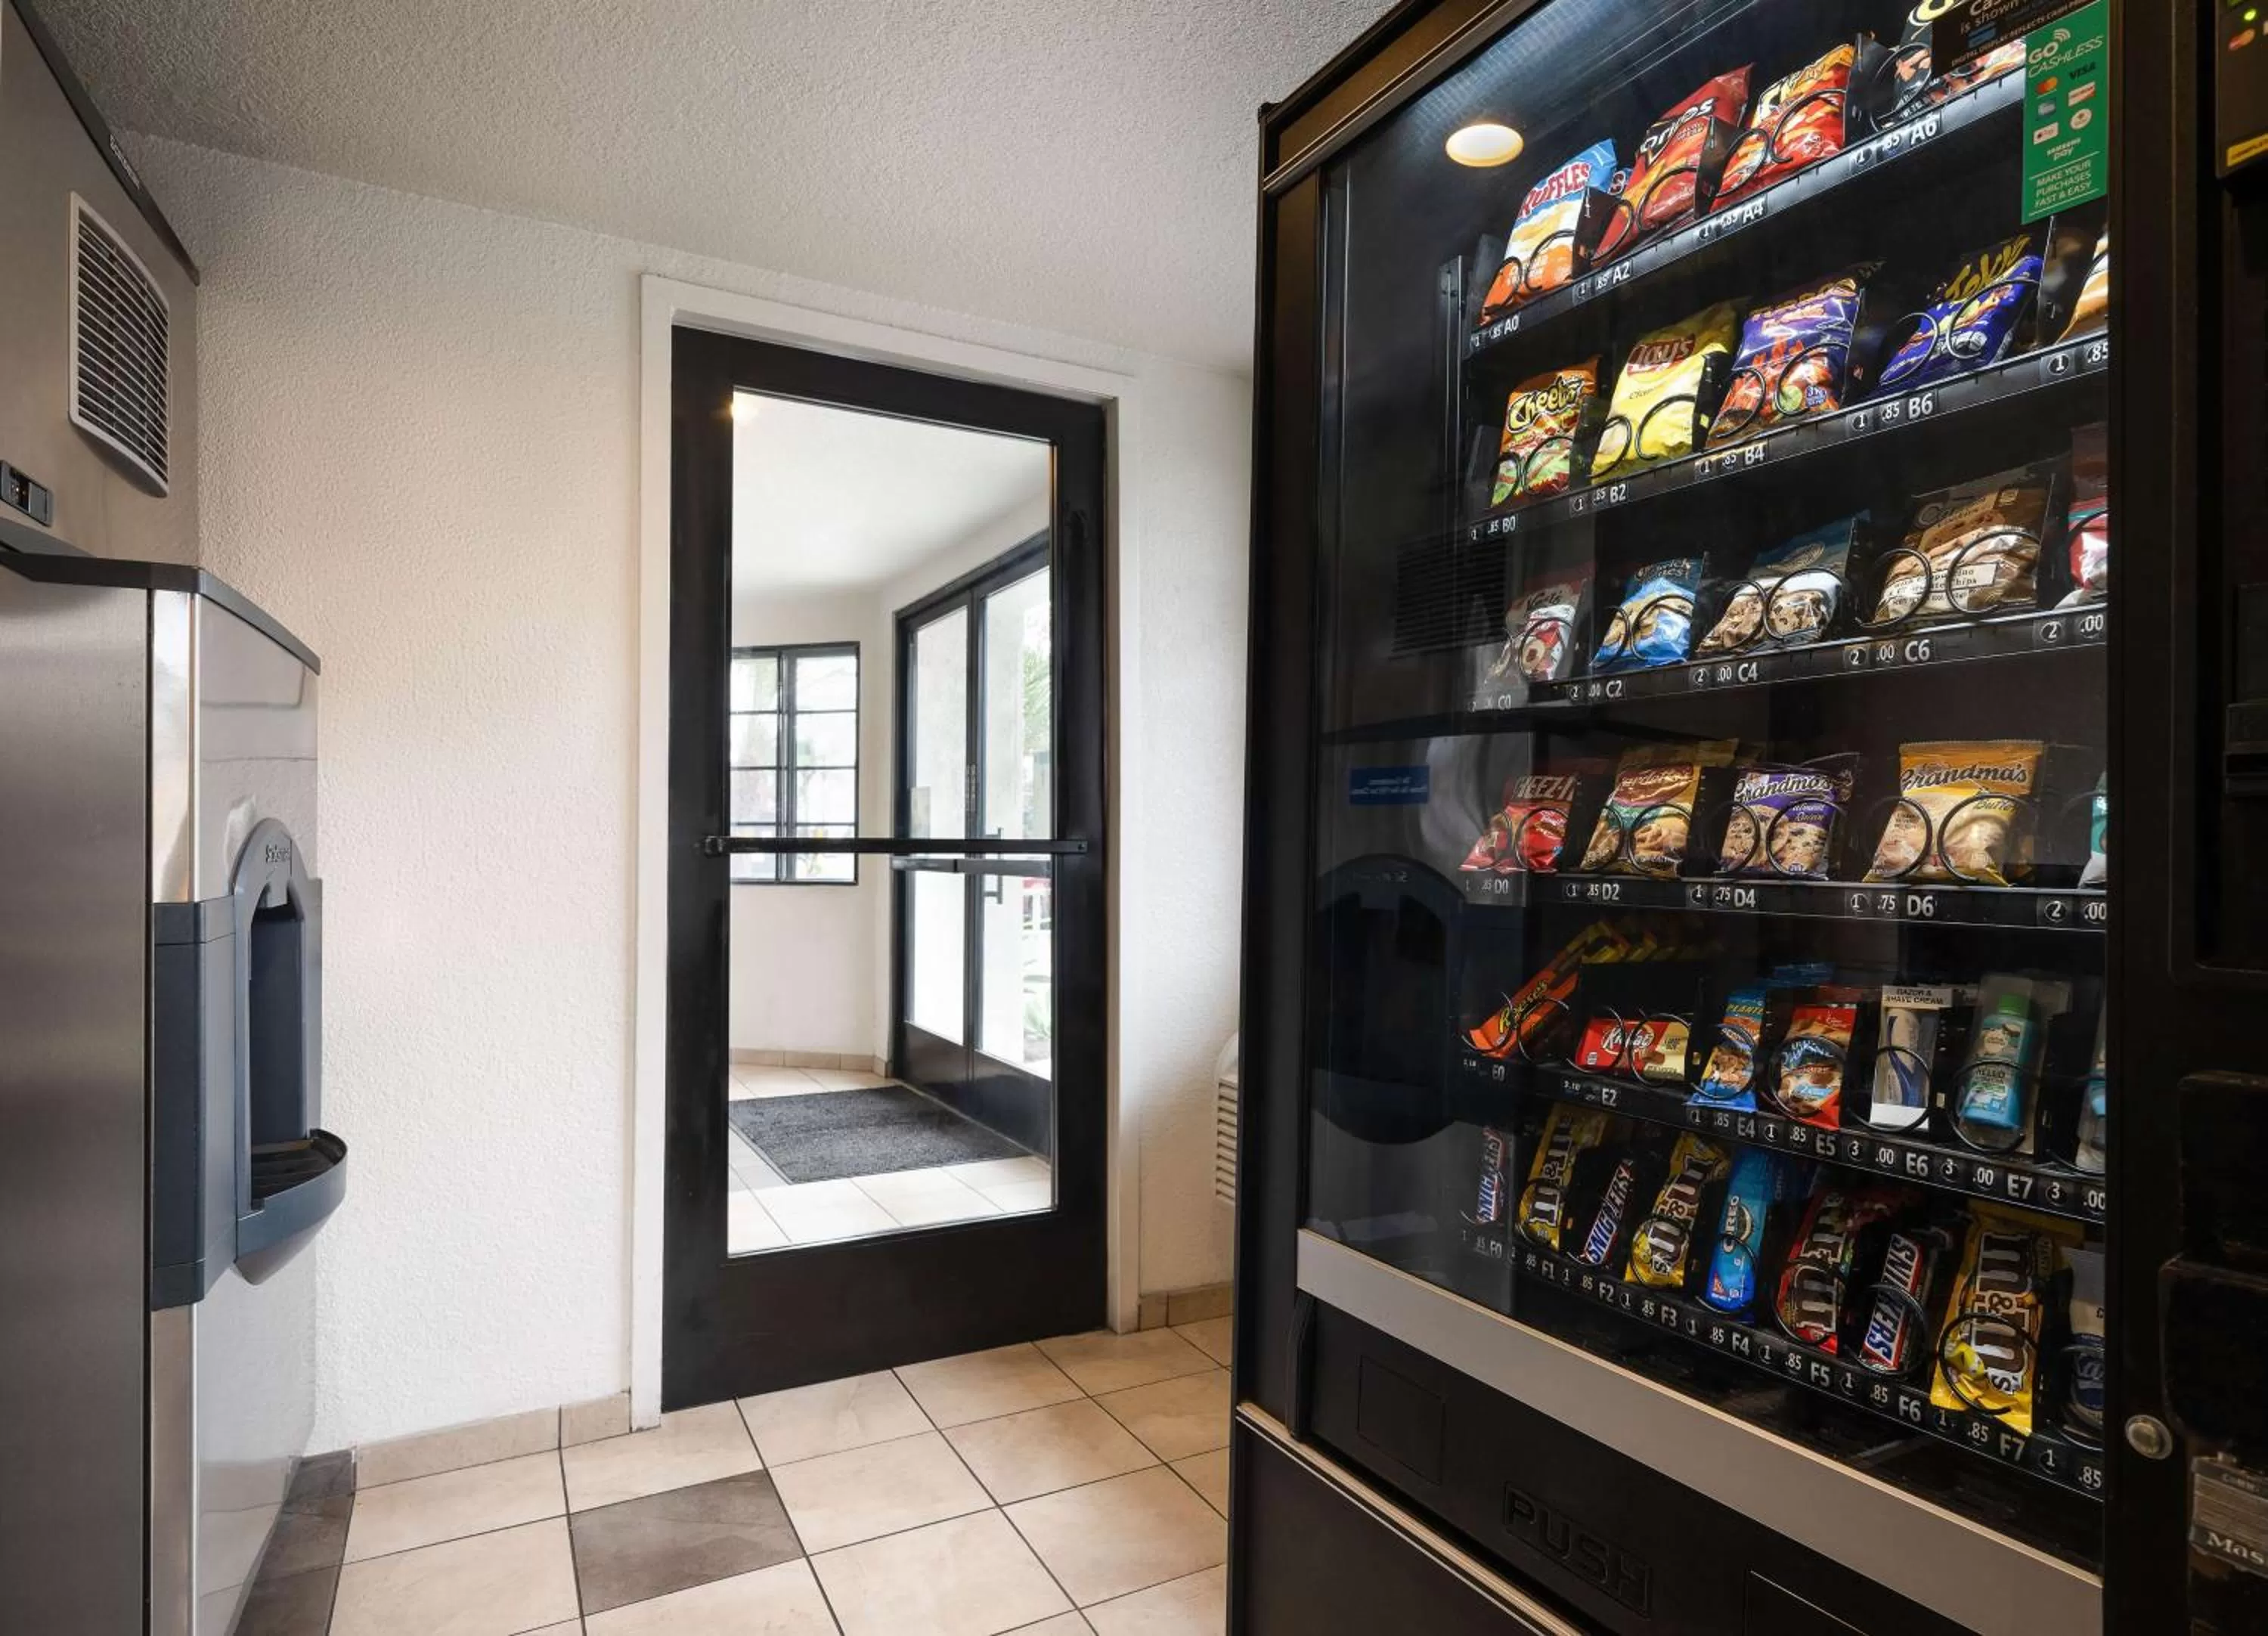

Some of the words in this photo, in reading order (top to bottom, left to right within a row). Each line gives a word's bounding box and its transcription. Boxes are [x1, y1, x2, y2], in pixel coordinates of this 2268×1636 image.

[2028, 42, 2059, 64] GO
[2028, 35, 2105, 79] CASHLESS
[1910, 119, 1938, 145] A6
[2036, 170, 2092, 198] PURCHASES
[2037, 170, 2063, 187] MAKE
[2065, 160, 2092, 175] YOUR
[1518, 162, 1592, 219] RUFFLES
[2034, 194, 2057, 208] FAST
[2068, 180, 2092, 197] EASY
[1742, 202, 1765, 224] A4
[1612, 262, 1631, 284] A2
[1503, 314, 1520, 336] A0
[1909, 393, 1933, 419] B6
[1745, 446, 1765, 465] B4
[1610, 484, 1627, 504] B2
[1502, 515, 1517, 533] B0
[2080, 614, 2104, 634] .00
[1876, 647, 1895, 662] .00
[1904, 640, 1931, 662] C6
[1738, 662, 1758, 682] C4
[1606, 680, 1622, 698] C2
[1498, 693, 1511, 710] C0
[1900, 762, 2028, 791] Grandma's
[1494, 878, 1509, 895] D0
[1602, 883, 1620, 900] D2
[1734, 888, 1756, 907] D4
[1877, 894, 1896, 911] .75
[1907, 895, 1935, 917] D6
[2084, 903, 2106, 919] .00
[1885, 995, 1912, 1003] SHAVE
[1913, 996, 1944, 1005] CREAM
[1491, 1064, 1506, 1082] E0
[1601, 1088, 1618, 1107] E2
[1737, 1116, 1755, 1138] E4
[1816, 1135, 1836, 1156] E5
[1875, 1148, 1895, 1163] .00
[1906, 1152, 1929, 1176] E6
[1972, 1168, 1994, 1186] .00
[2007, 1174, 2034, 1199] E7
[2084, 1190, 2105, 1210] .00
[1489, 1239, 1503, 1258] F0
[1541, 1260, 1554, 1280] F1
[1599, 1283, 1614, 1303] F2
[1660, 1308, 1677, 1327] F3
[1732, 1334, 1749, 1356] F4
[1811, 1362, 1830, 1387] F5
[1898, 1396, 1922, 1422] F6
[1968, 1422, 1989, 1442] .85
[2000, 1432, 2025, 1461] F7
[2078, 1466, 2102, 1488] .85
[1504, 1483, 1653, 1613] PUSH
